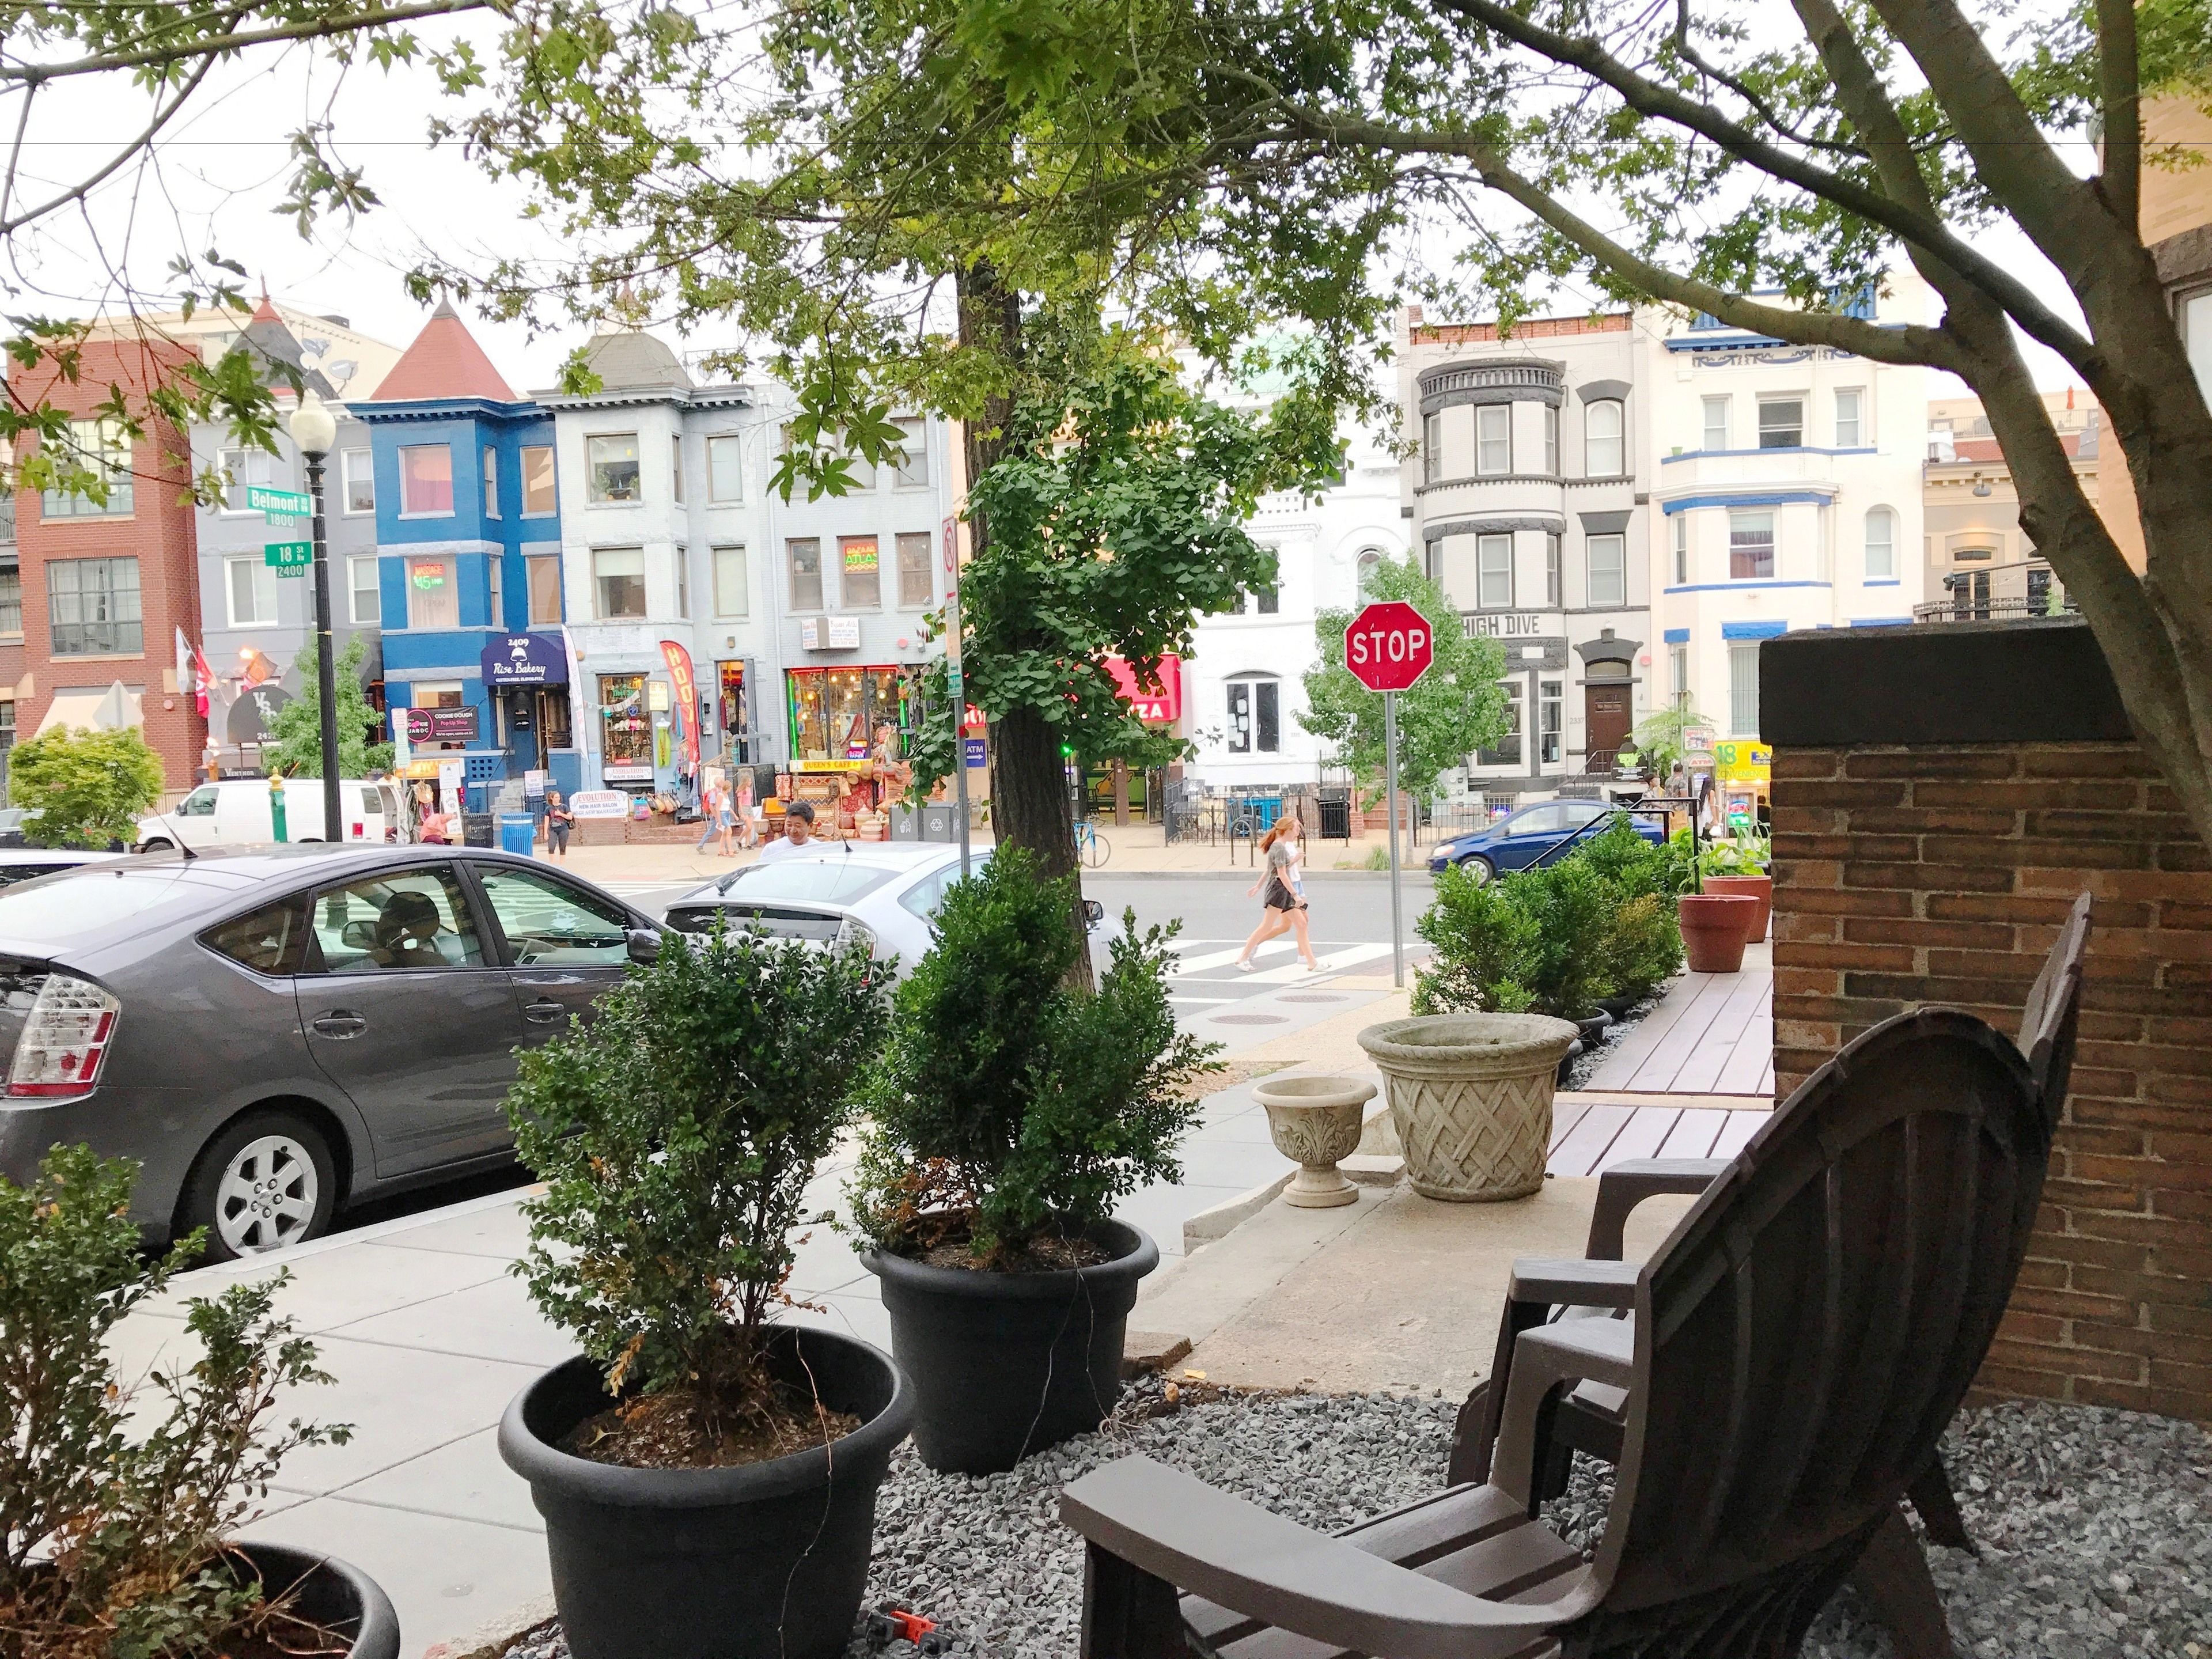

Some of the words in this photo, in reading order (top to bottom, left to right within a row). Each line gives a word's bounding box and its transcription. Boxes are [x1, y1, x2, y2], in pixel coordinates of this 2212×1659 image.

[251, 490, 298, 512] Belmont
[271, 513, 294, 527] 1800
[279, 546, 292, 562] 18
[846, 546, 876, 554] BAZAAR
[846, 553, 877, 564] ATLAS
[278, 565, 302, 577] 2400
[414, 565, 443, 576] MASSAGE
[1461, 616, 1499, 636] HIGH
[1505, 615, 1540, 634] DIVE
[507, 638, 529, 647] 2409
[1352, 629, 1425, 664] STOP
[493, 662, 513, 675] Rise
[514, 662, 546, 676] Bakery
[804, 762, 831, 770] QUEEN'S
[1717, 770, 1768, 778] CONVENIENCE
[578, 792, 616, 801] EVOLUTION
